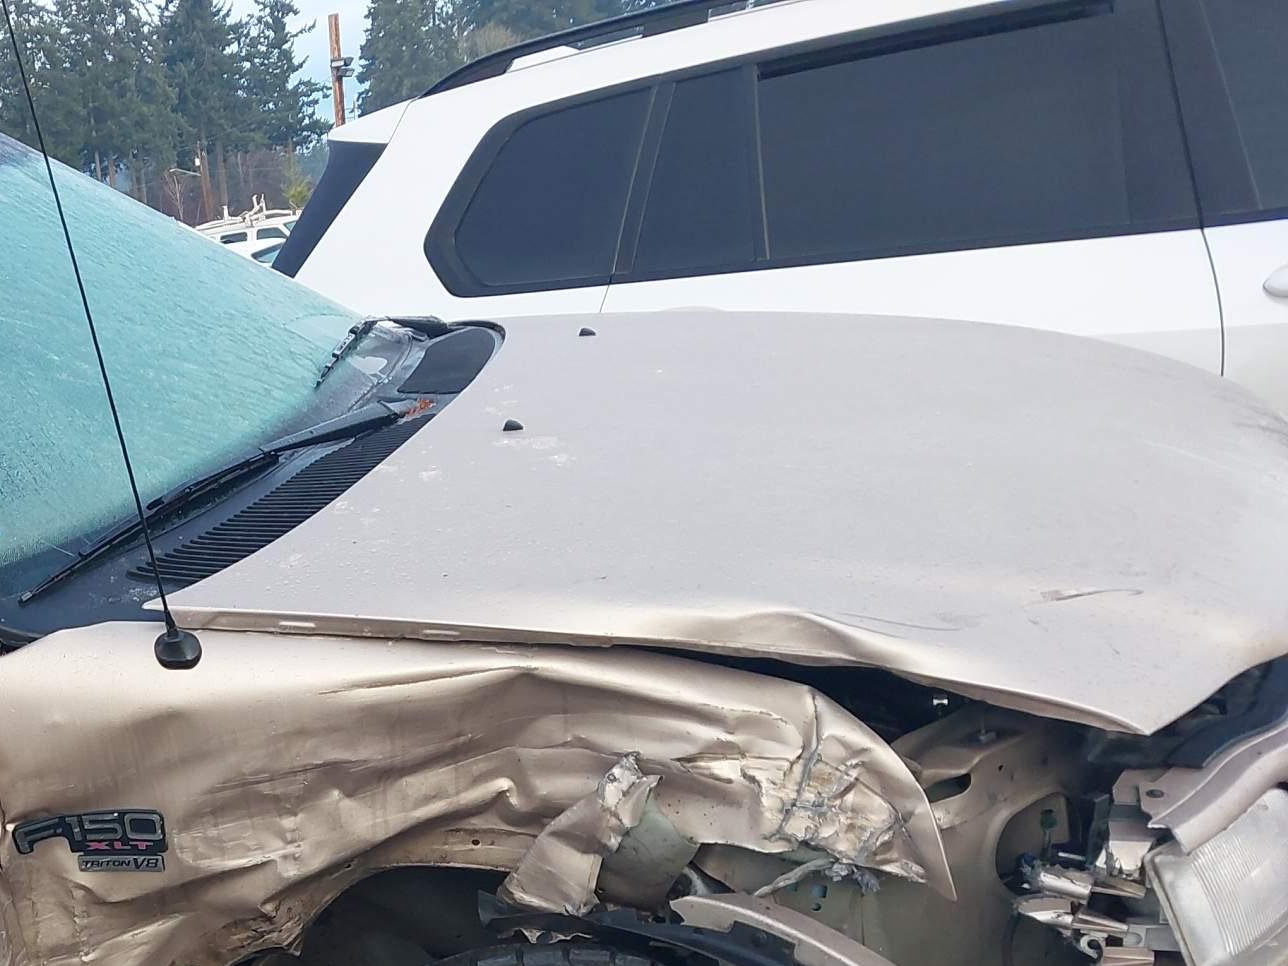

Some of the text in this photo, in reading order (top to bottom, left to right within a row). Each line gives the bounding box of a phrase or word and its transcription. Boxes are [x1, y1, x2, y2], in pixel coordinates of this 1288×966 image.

[85, 841, 154, 850] XLT
[82, 858, 159, 869] TRITON V8
